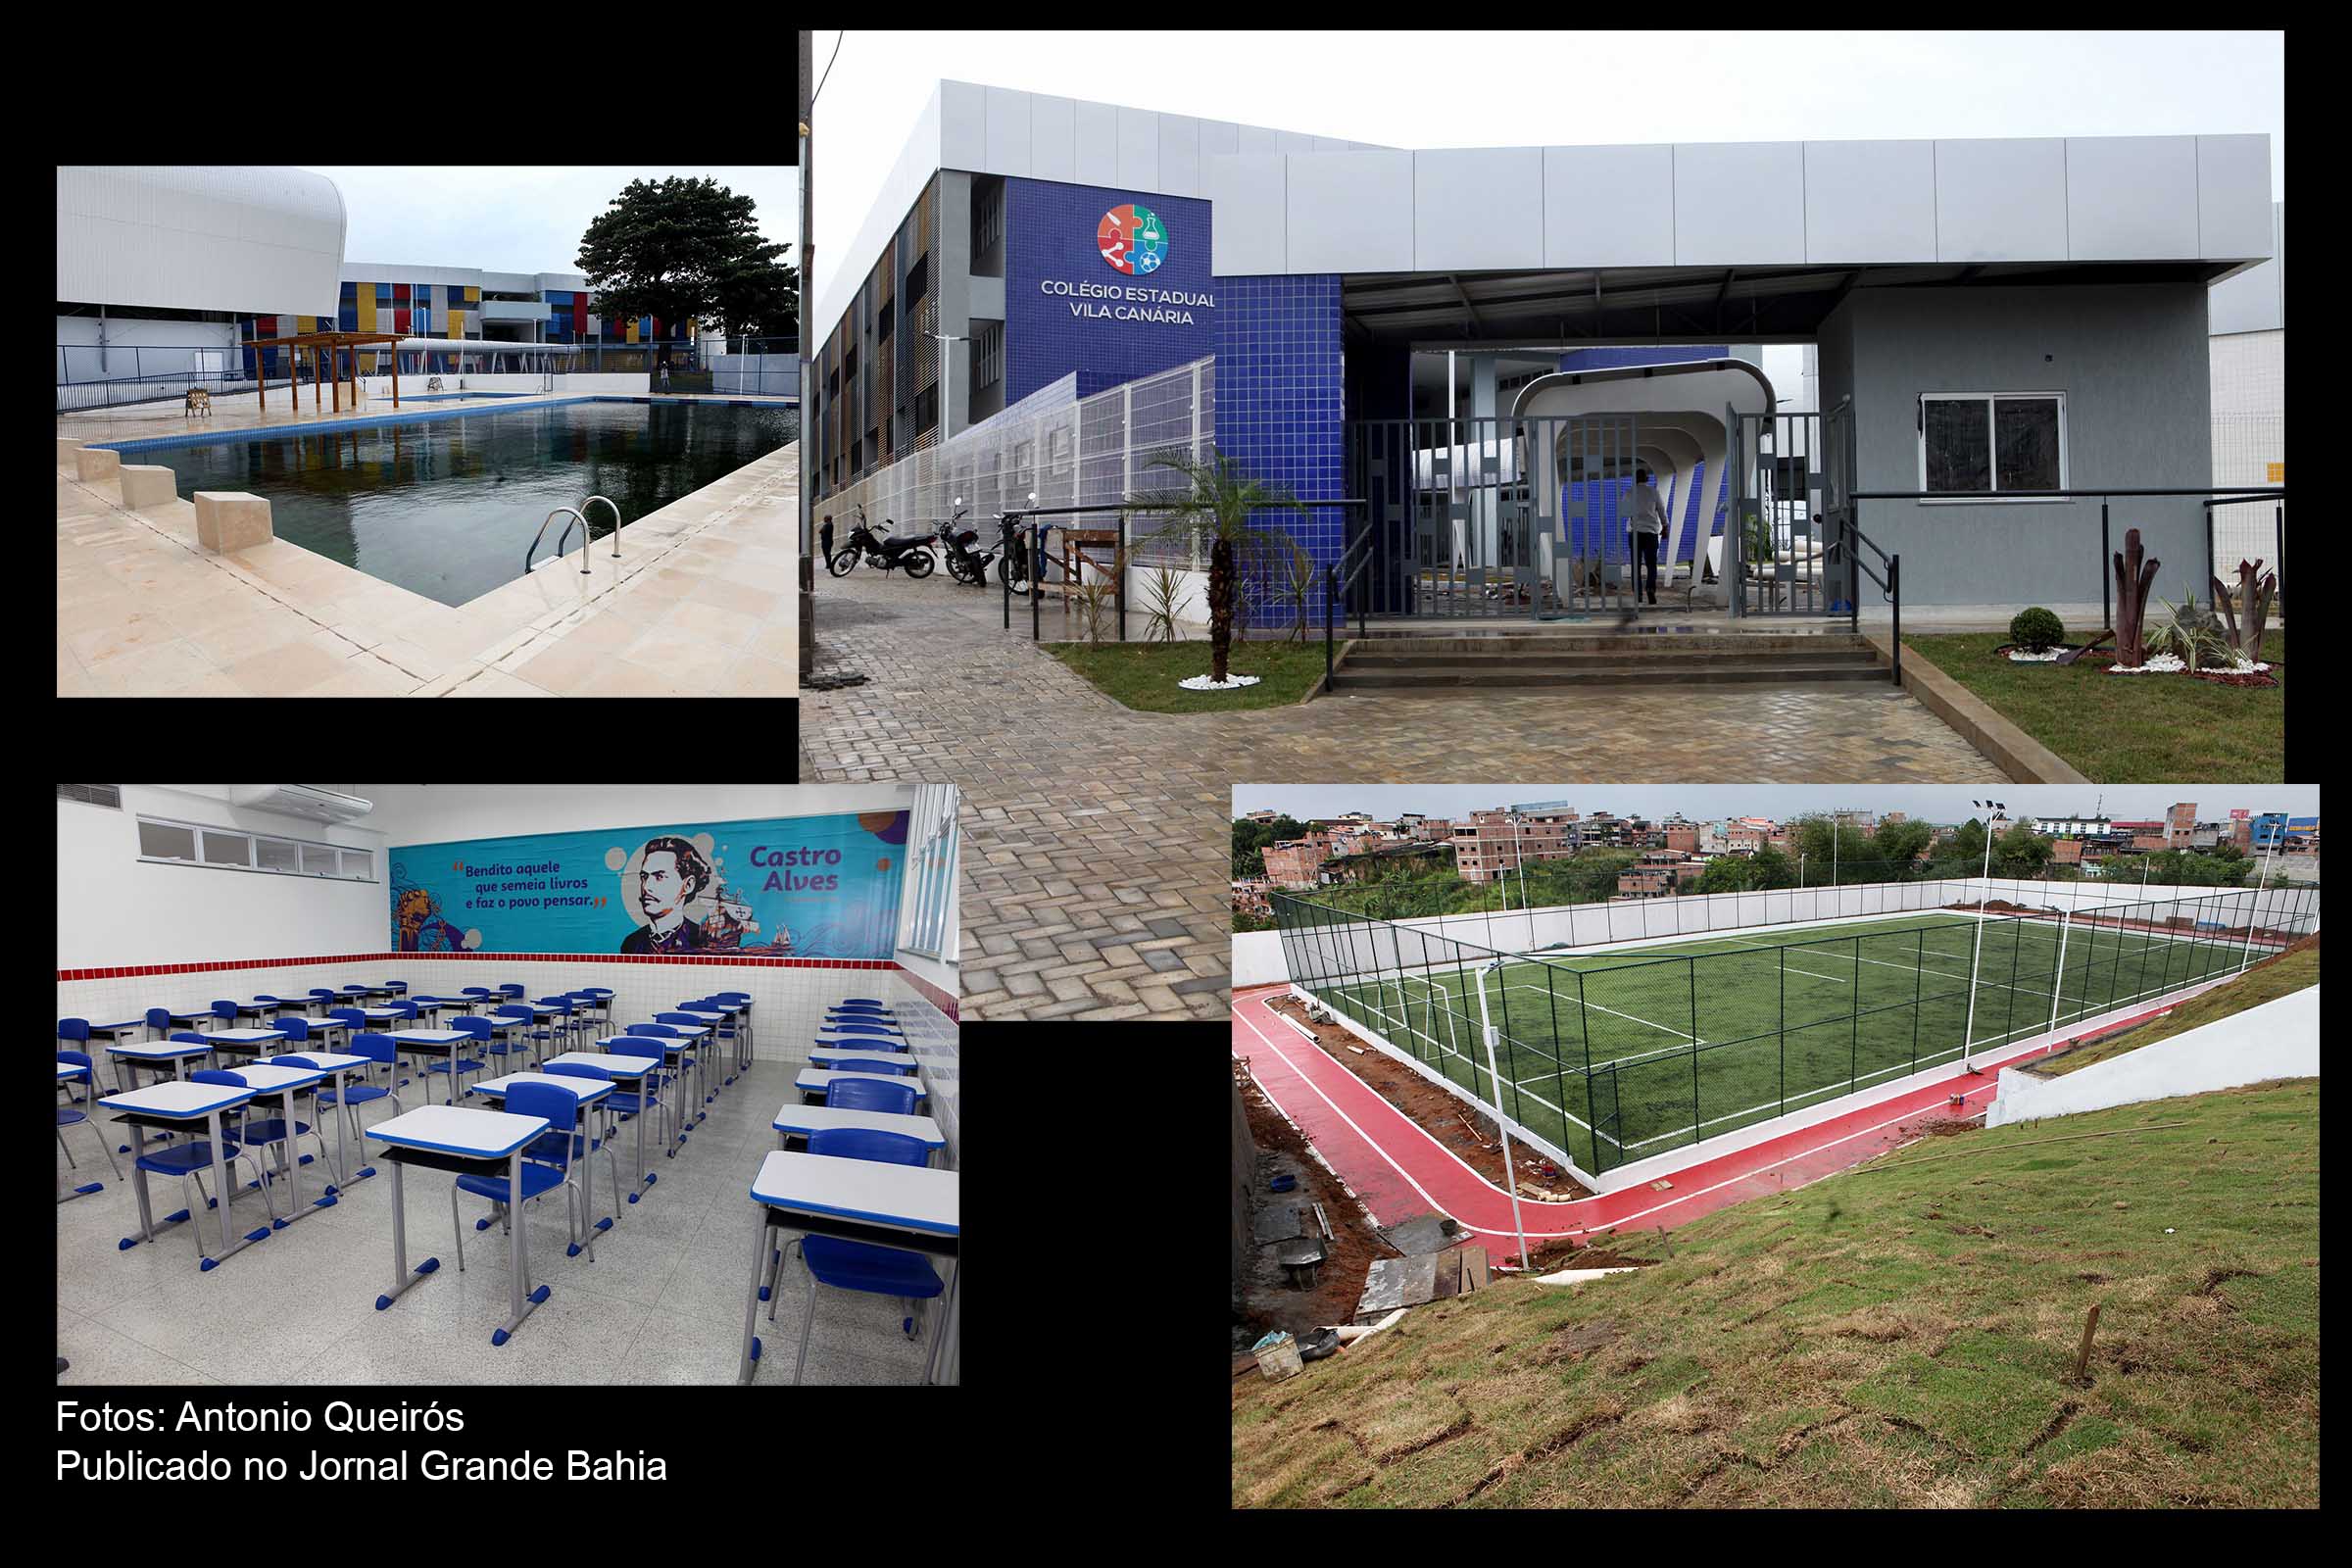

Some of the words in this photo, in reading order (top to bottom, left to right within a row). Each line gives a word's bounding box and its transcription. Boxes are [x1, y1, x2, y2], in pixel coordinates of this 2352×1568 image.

[1041, 280, 1122, 300] COLÉGIO
[1126, 287, 1215, 308] ESTADUAL
[1069, 302, 1112, 319] VILA
[1115, 306, 1195, 325] CANÁRIA
[750, 846, 842, 867] Castro
[516, 860, 561, 877] aquele
[475, 882, 498, 895] que
[501, 878, 546, 892] semeia
[550, 877, 588, 891] livros
[762, 869, 839, 892] Alves
[466, 900, 472, 909] e
[476, 897, 495, 908] faz
[498, 899, 506, 908] o
[509, 898, 540, 910] povo
